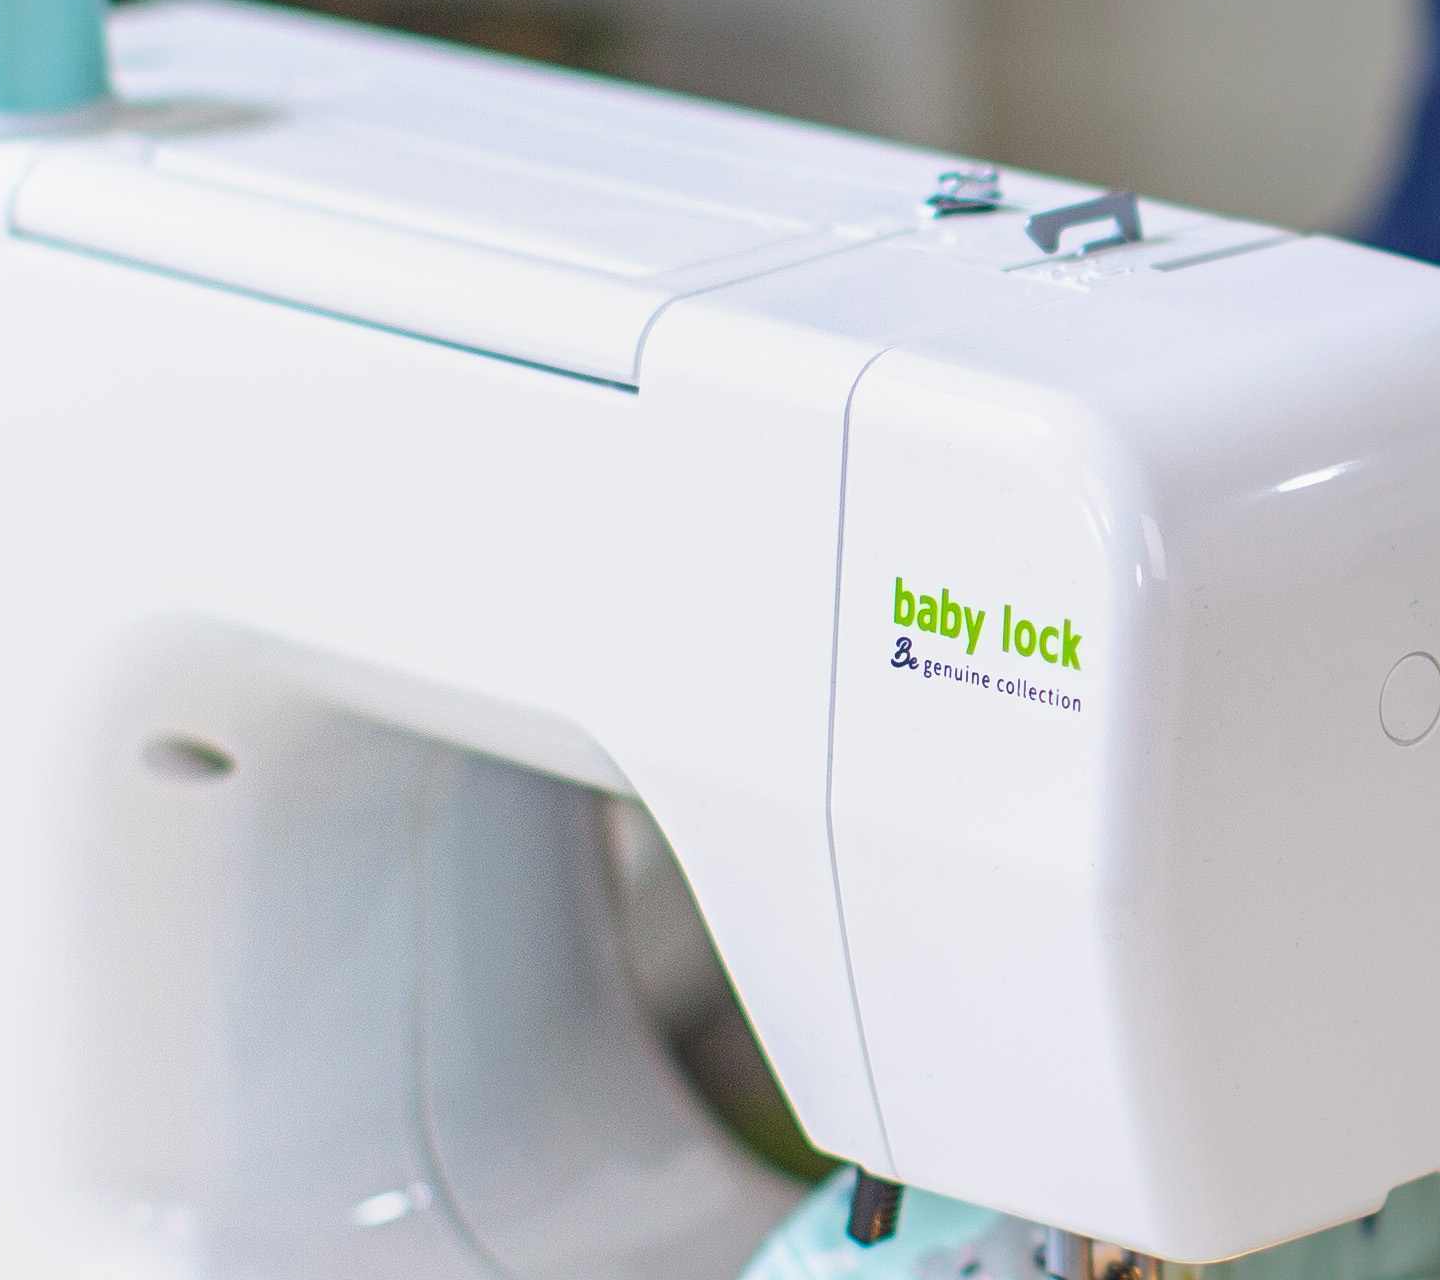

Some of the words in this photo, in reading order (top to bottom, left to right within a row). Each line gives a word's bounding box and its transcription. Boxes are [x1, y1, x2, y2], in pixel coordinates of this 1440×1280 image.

[894, 576, 986, 656] baby
[1002, 604, 1083, 671] lock
[891, 636, 919, 669] Be
[923, 659, 991, 689] genuine
[996, 676, 1081, 712] collection
